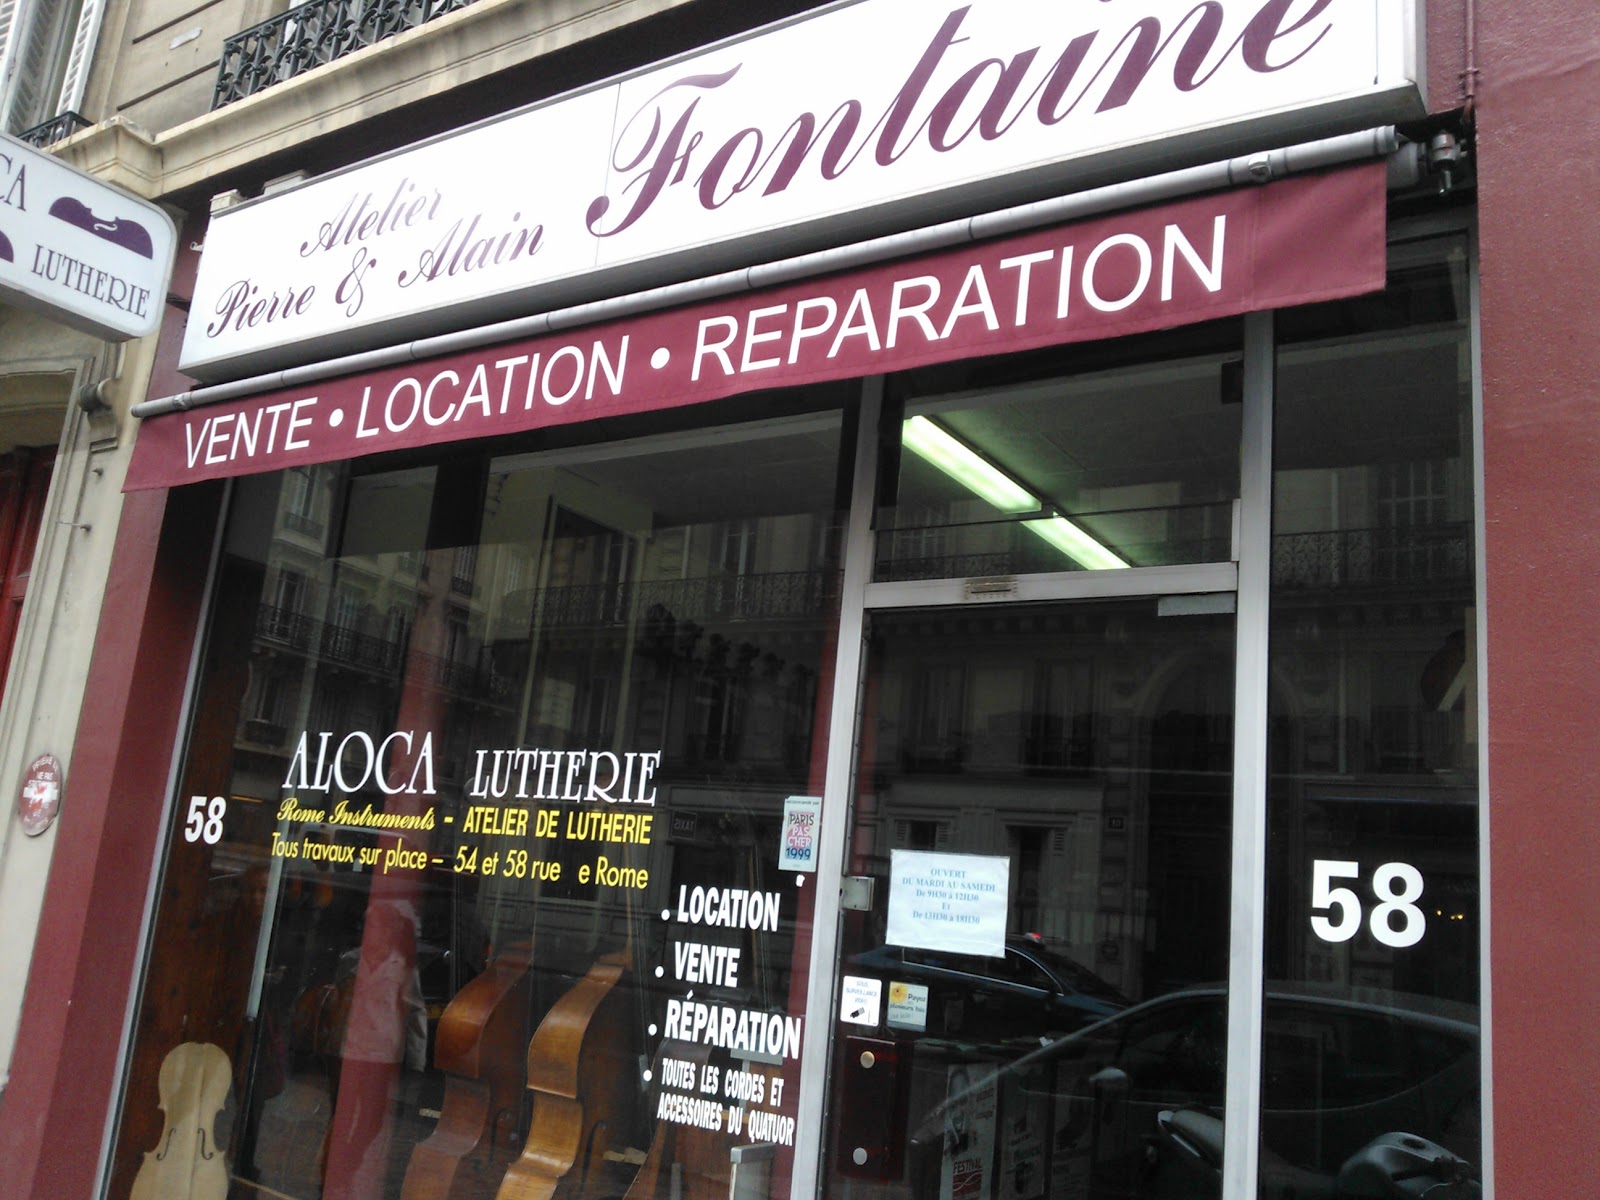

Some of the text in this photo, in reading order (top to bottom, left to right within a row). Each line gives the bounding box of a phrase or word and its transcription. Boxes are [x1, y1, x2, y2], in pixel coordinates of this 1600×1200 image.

[585, 0, 1333, 237] Fontaine
[300, 177, 443, 257] Atelier
[31, 244, 150, 318] LUTHERIE
[206, 212, 544, 338] Pierre & Alain
[185, 215, 1226, 469] VENTE LOCATION REPARATION
[282, 731, 661, 807] ALOCA LUTHERIE
[185, 796, 226, 844] 58
[277, 797, 325, 823] Rome
[328, 799, 436, 831] Instruments
[463, 806, 528, 837] ATELIER
[536, 812, 558, 839] DE
[567, 812, 653, 845] LUTHERIE
[787, 836, 812, 848] CHER
[789, 813, 814, 826] PARIS
[791, 826, 809, 837] PAS
[272, 832, 299, 859] Tous
[302, 837, 355, 864] travaux
[359, 847, 381, 867] sur
[384, 837, 427, 874] place
[454, 846, 477, 874] 54
[482, 851, 499, 876] et
[503, 851, 527, 879] 58
[531, 858, 561, 882] rue
[595, 857, 649, 890] Rome
[785, 848, 811, 859] 1999
[930, 868, 967, 878] OUVERT
[677, 885, 780, 932] LOCATION
[902, 877, 996, 892] DU MARDI AU SAMEDI
[916, 889, 926, 897] De
[1310, 859, 1427, 948] 58
[912, 910, 923, 918] De
[674, 941, 741, 988] VENTE
[664, 990, 801, 1060] RÉPARATION
[661, 1057, 784, 1107] TOUTES LES CORDES ET
[657, 1092, 795, 1146] ACCESSOIRES DU QUATUOR
[953, 1157, 982, 1174] FESTIVAL
